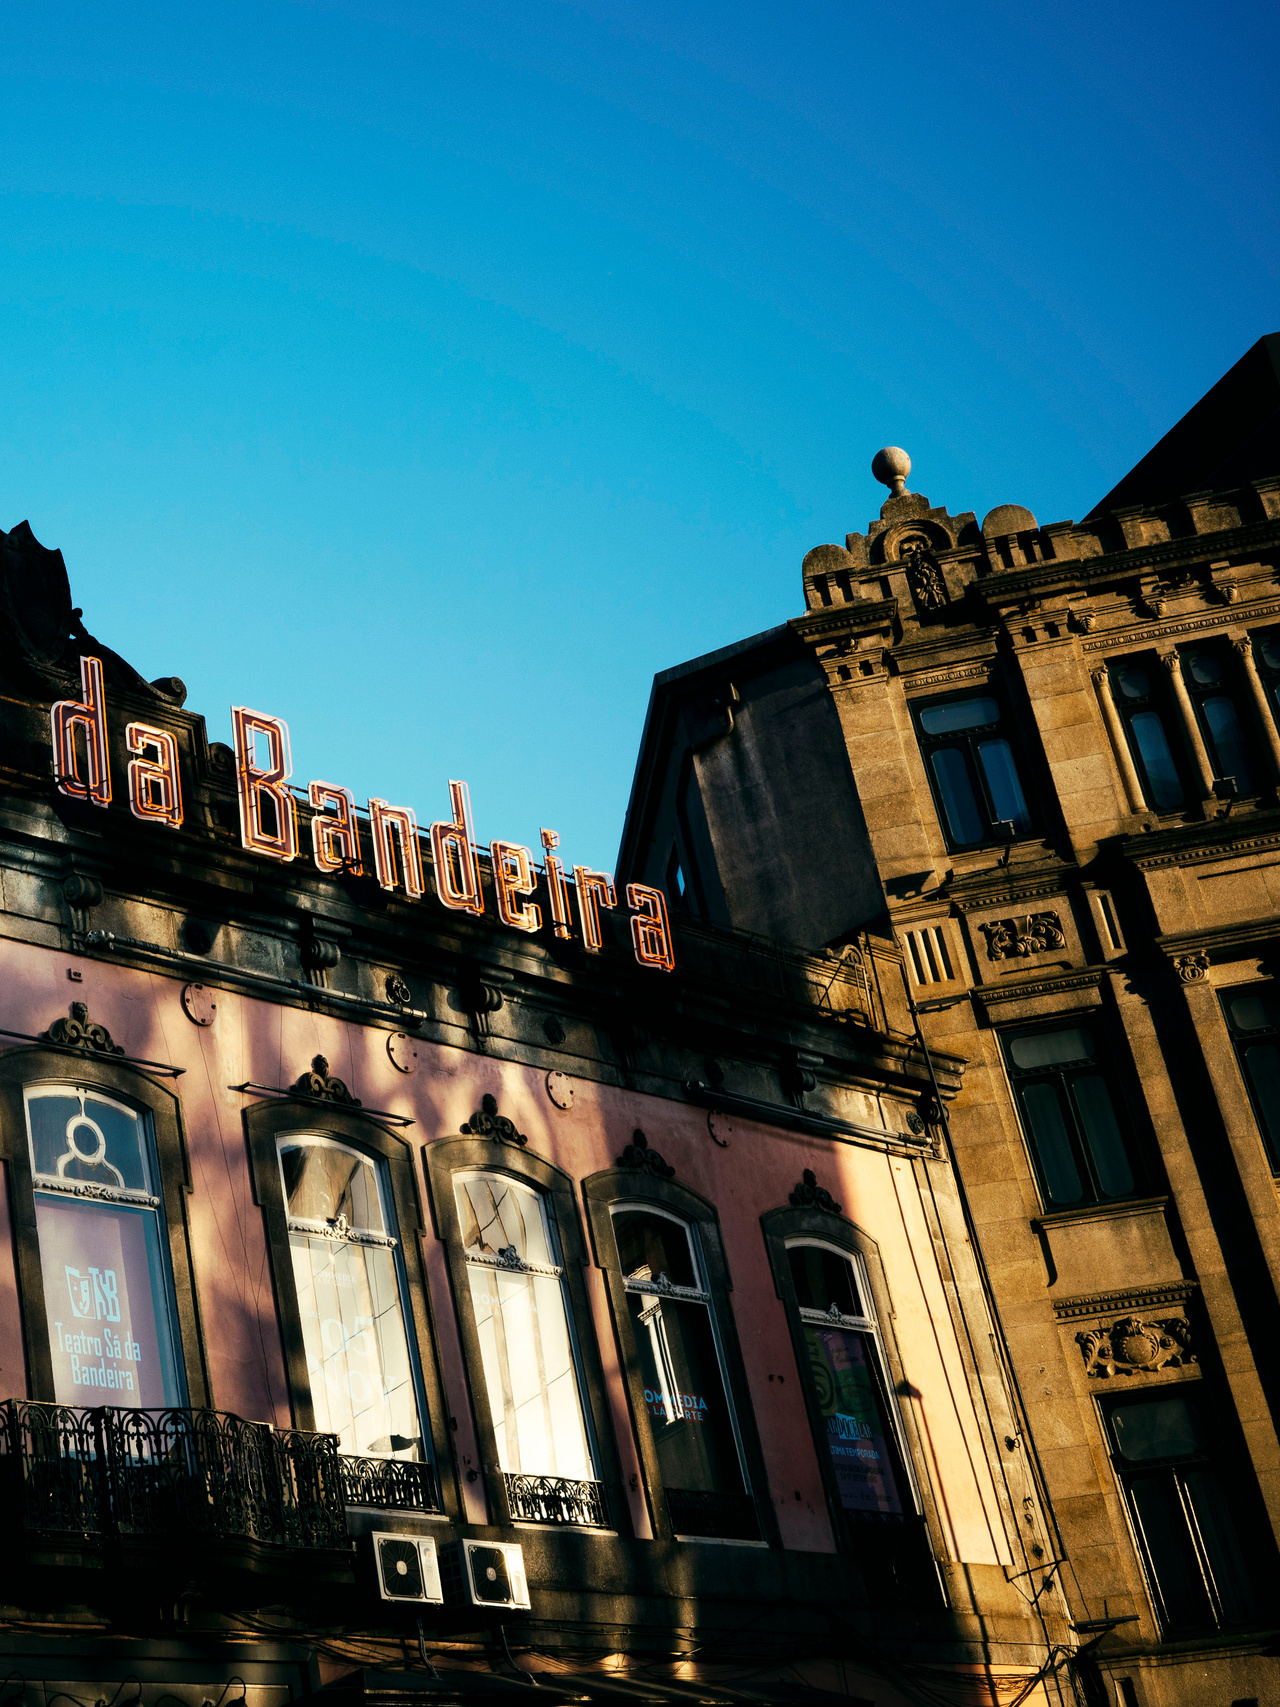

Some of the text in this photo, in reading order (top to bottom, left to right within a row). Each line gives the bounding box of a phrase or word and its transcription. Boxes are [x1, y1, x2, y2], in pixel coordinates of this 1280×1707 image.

[50, 655, 185, 830] da
[230, 705, 676, 972] Bandeira
[54, 1321, 142, 1362] Teatro Sá da
[70, 1354, 135, 1391] Bandeira
[644, 1389, 708, 1411] OMEDIA
